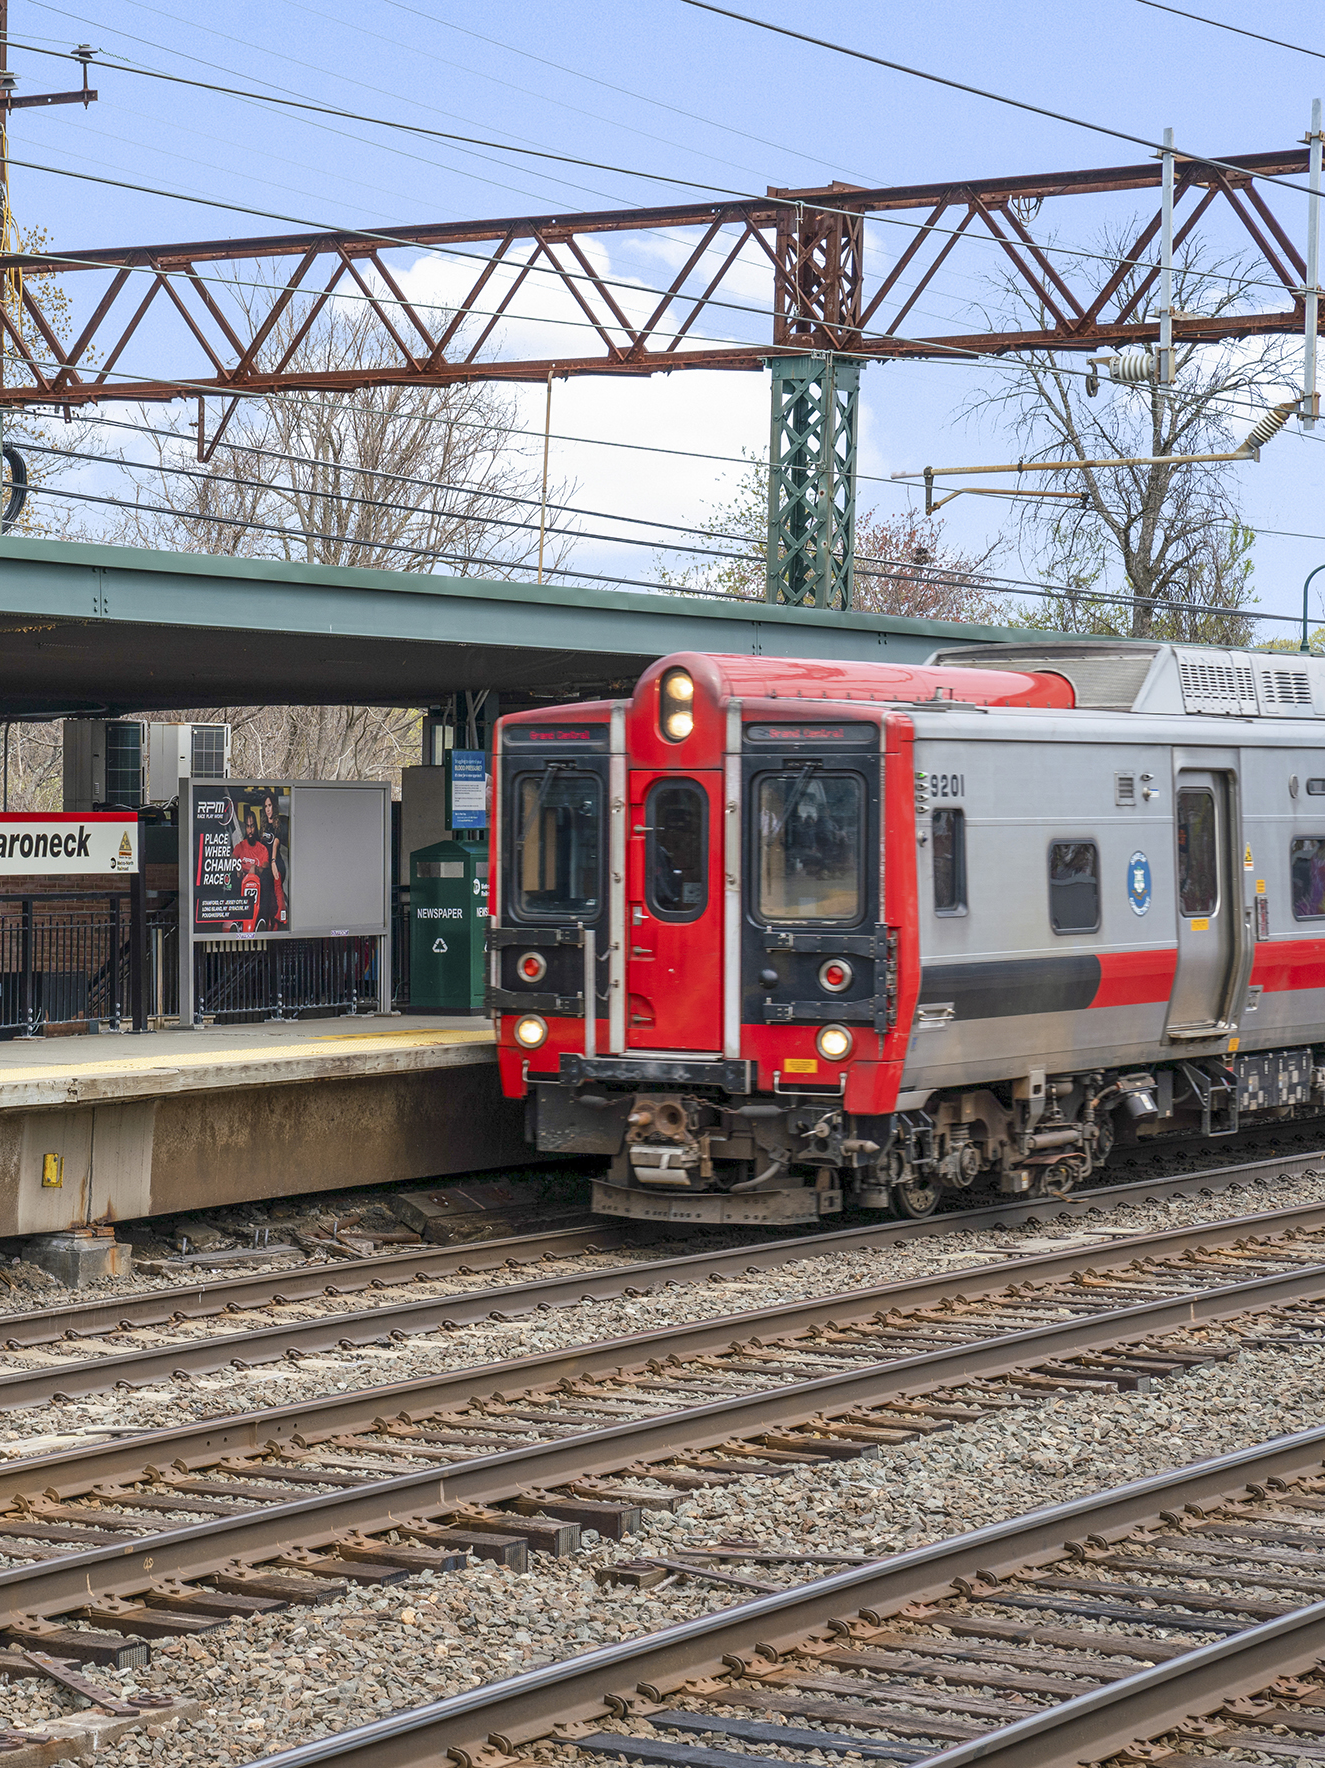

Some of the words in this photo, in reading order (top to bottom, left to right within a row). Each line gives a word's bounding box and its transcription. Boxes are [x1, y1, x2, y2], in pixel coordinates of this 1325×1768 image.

[529, 731, 555, 740] Grand
[556, 730, 590, 739] Central
[769, 728, 800, 738] Grand
[803, 728, 845, 738] Central
[930, 774, 965, 797] 9201
[197, 801, 225, 813] RPM
[204, 833, 229, 845] PLACE
[204, 846, 231, 857] WHERE
[204, 858, 242, 872] CHAMPS
[203, 873, 224, 885] RACE
[417, 908, 463, 919] NEWSPAPER
